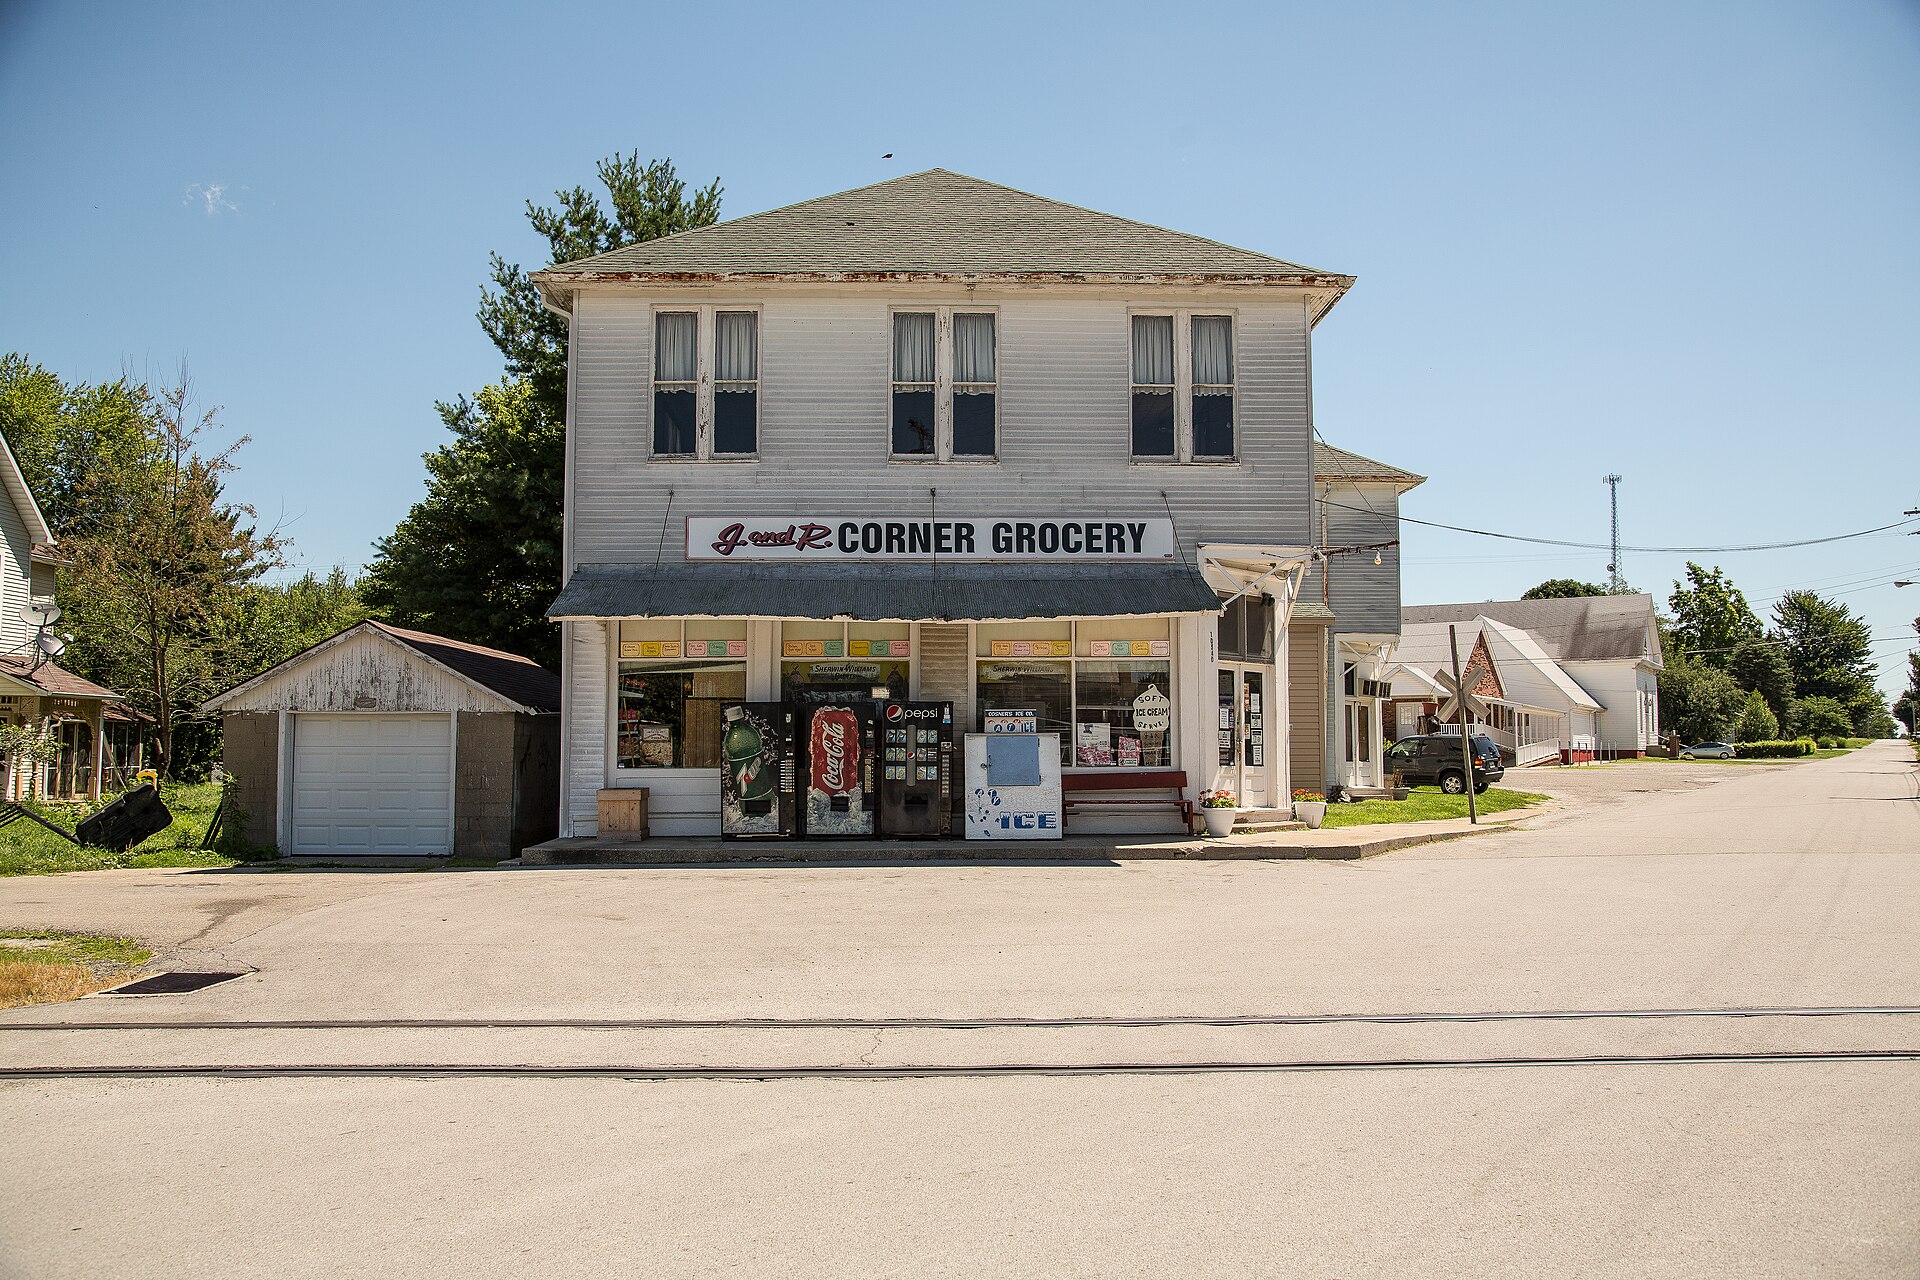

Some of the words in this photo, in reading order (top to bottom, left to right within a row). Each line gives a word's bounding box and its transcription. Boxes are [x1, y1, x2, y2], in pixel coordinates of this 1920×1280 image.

[748, 525, 797, 547] and
[838, 522, 975, 554] CORNER
[991, 522, 1146, 554] GROCERY
[1138, 695, 1164, 704] SOFT
[904, 708, 938, 720] pepsi
[1136, 708, 1146, 717] ICE
[1147, 707, 1168, 716] CREAM
[1138, 721, 1164, 729] SERVE
[1000, 811, 1056, 829] ICE
